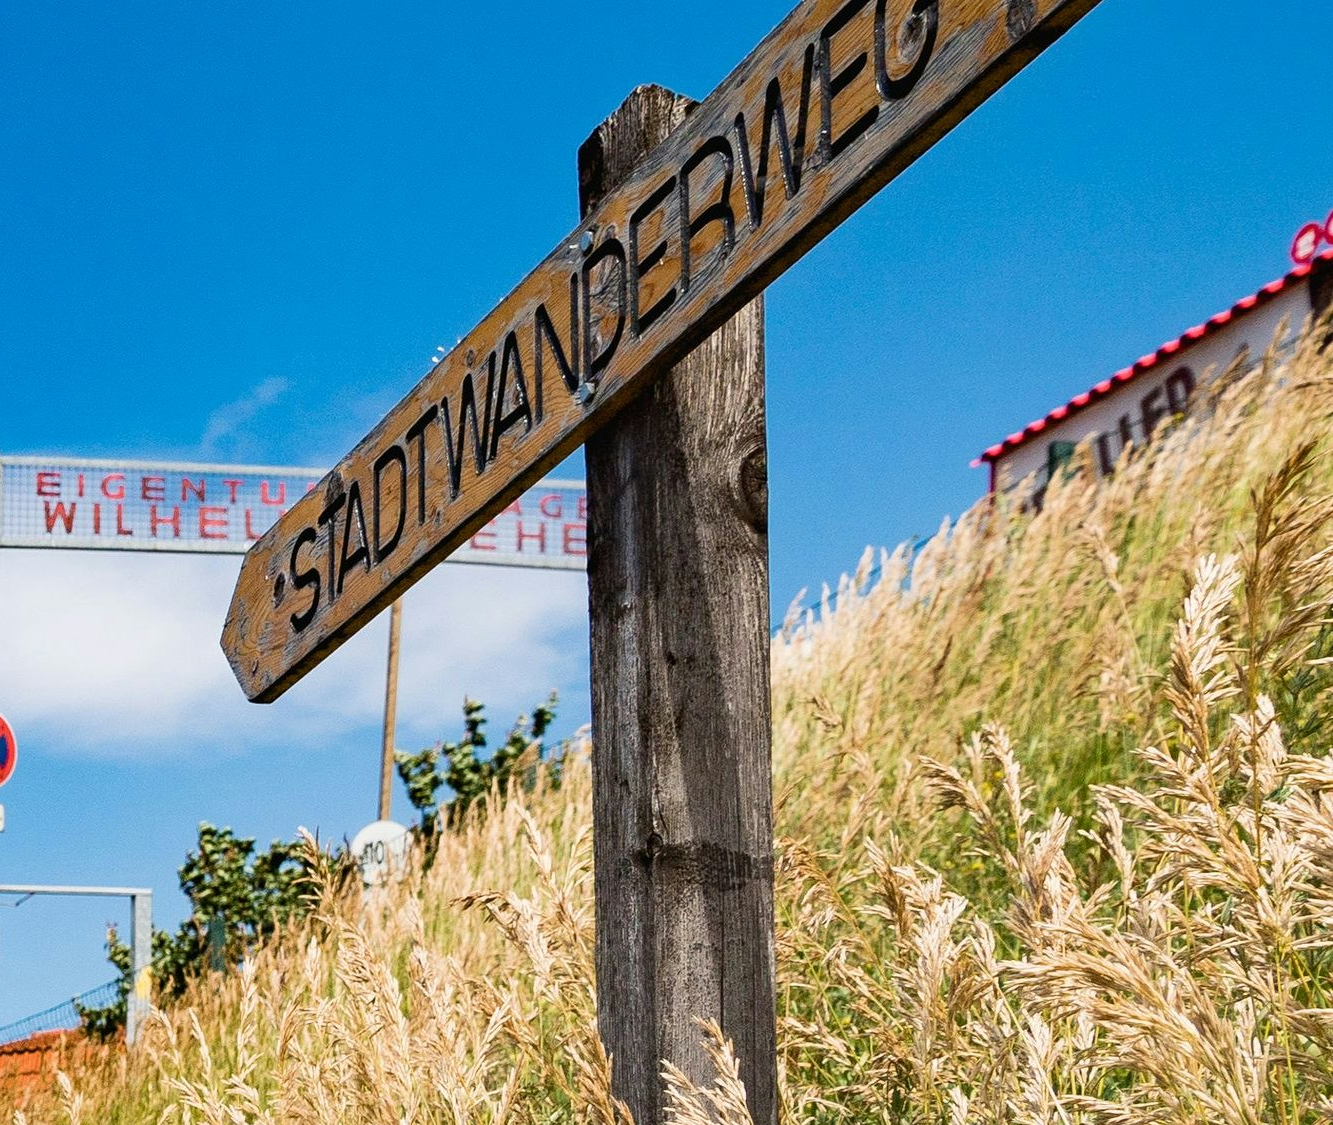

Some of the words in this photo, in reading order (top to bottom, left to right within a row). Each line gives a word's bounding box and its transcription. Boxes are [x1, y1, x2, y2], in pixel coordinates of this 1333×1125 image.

[289, 0, 940, 633] STADTWANDERWEG
[36, 471, 313, 506] EIGENTU
[44, 500, 290, 541] WILHEL
